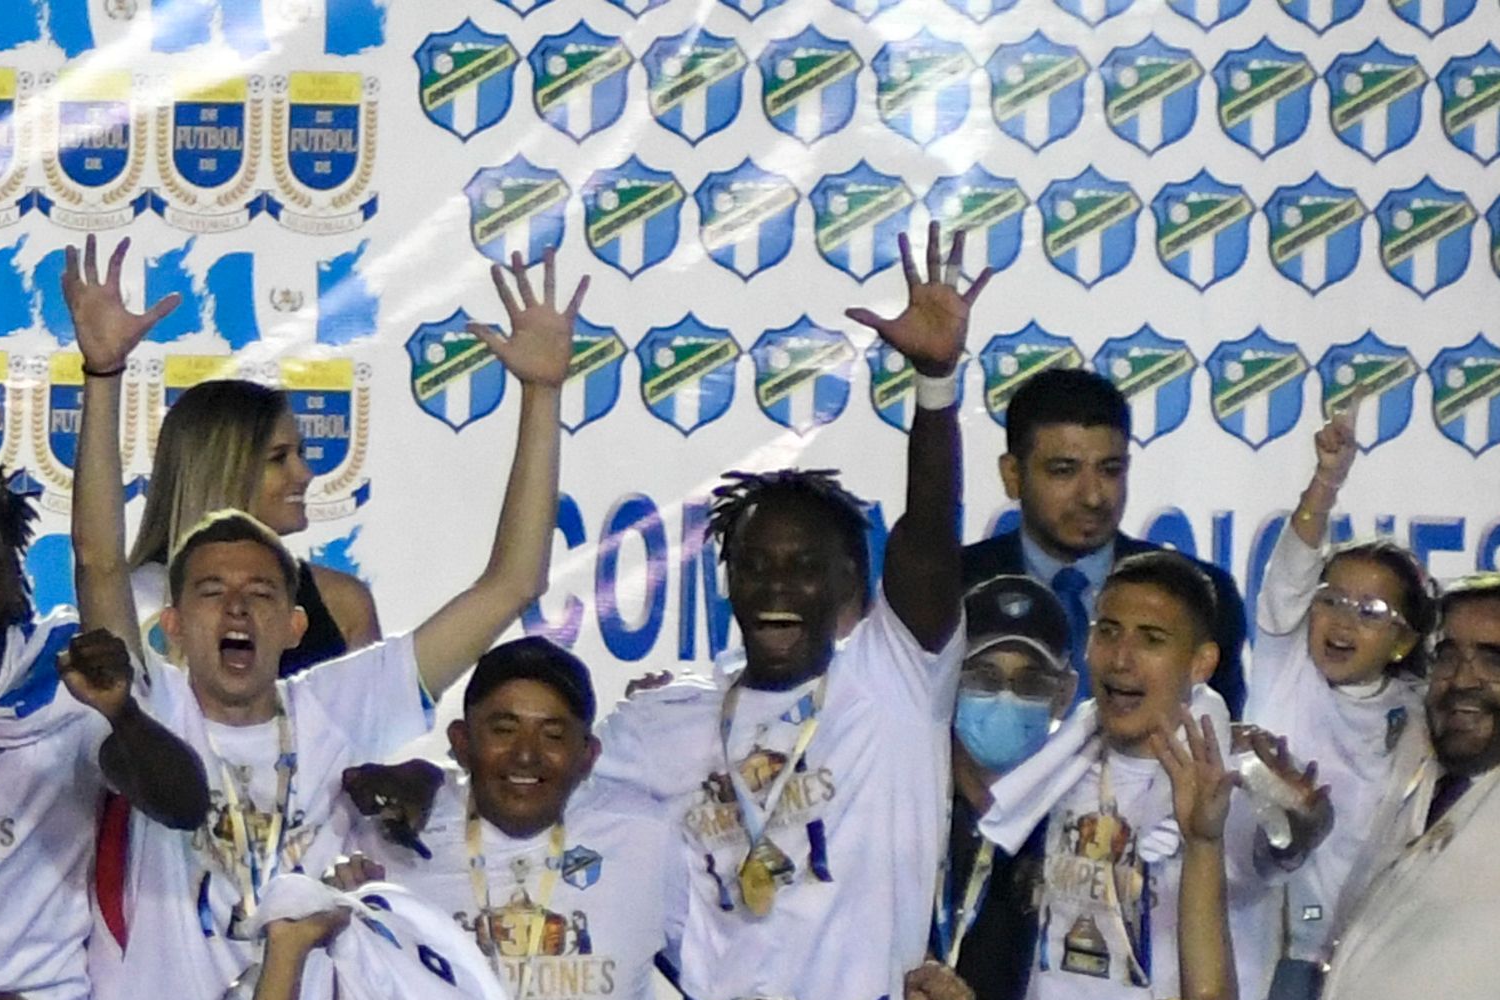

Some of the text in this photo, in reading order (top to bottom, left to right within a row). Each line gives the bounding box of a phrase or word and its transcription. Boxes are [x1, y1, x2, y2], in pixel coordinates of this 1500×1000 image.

[175, 127, 242, 151] FUTBOL
[290, 128, 358, 152] FUTBOL
[52, 409, 82, 433] FUT
